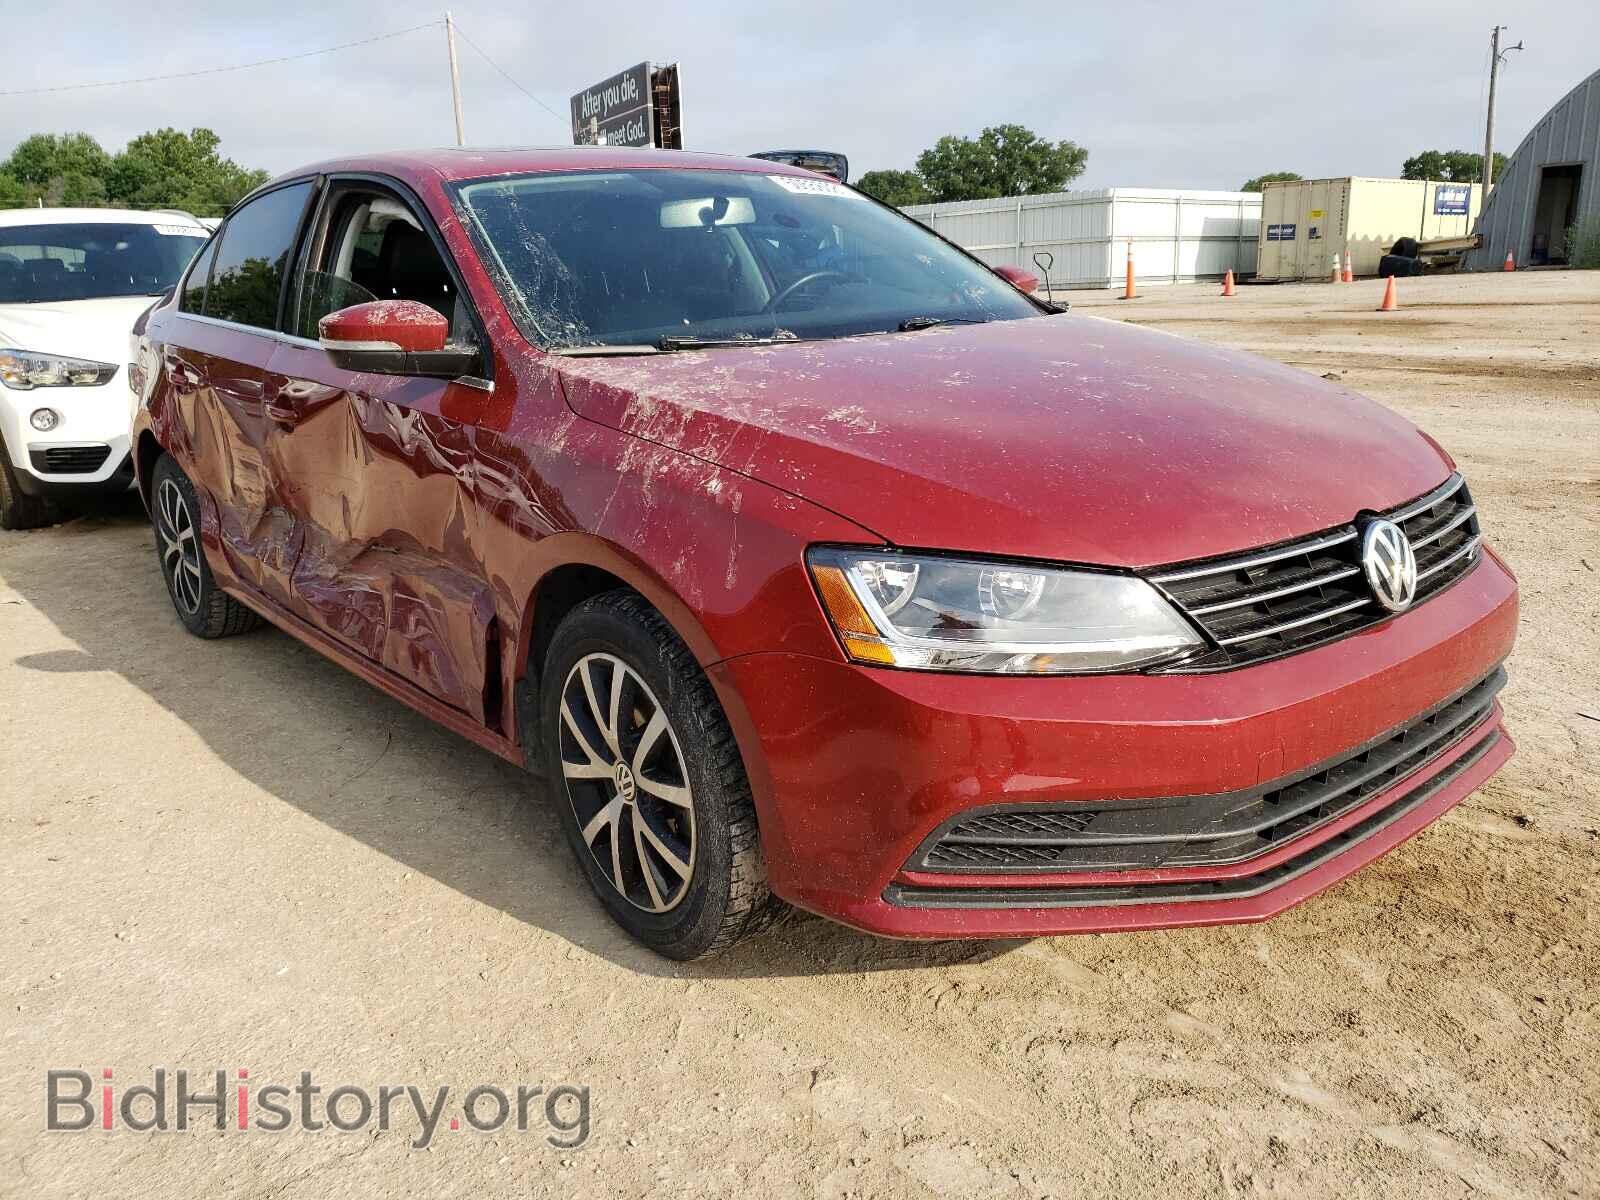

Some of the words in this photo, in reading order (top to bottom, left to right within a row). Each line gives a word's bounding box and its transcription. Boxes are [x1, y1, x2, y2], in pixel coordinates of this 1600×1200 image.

[582, 90, 601, 119] After
[602, 85, 620, 117] you
[621, 73, 639, 101] die,
[607, 125, 626, 146] meet
[627, 116, 646, 142] God.
